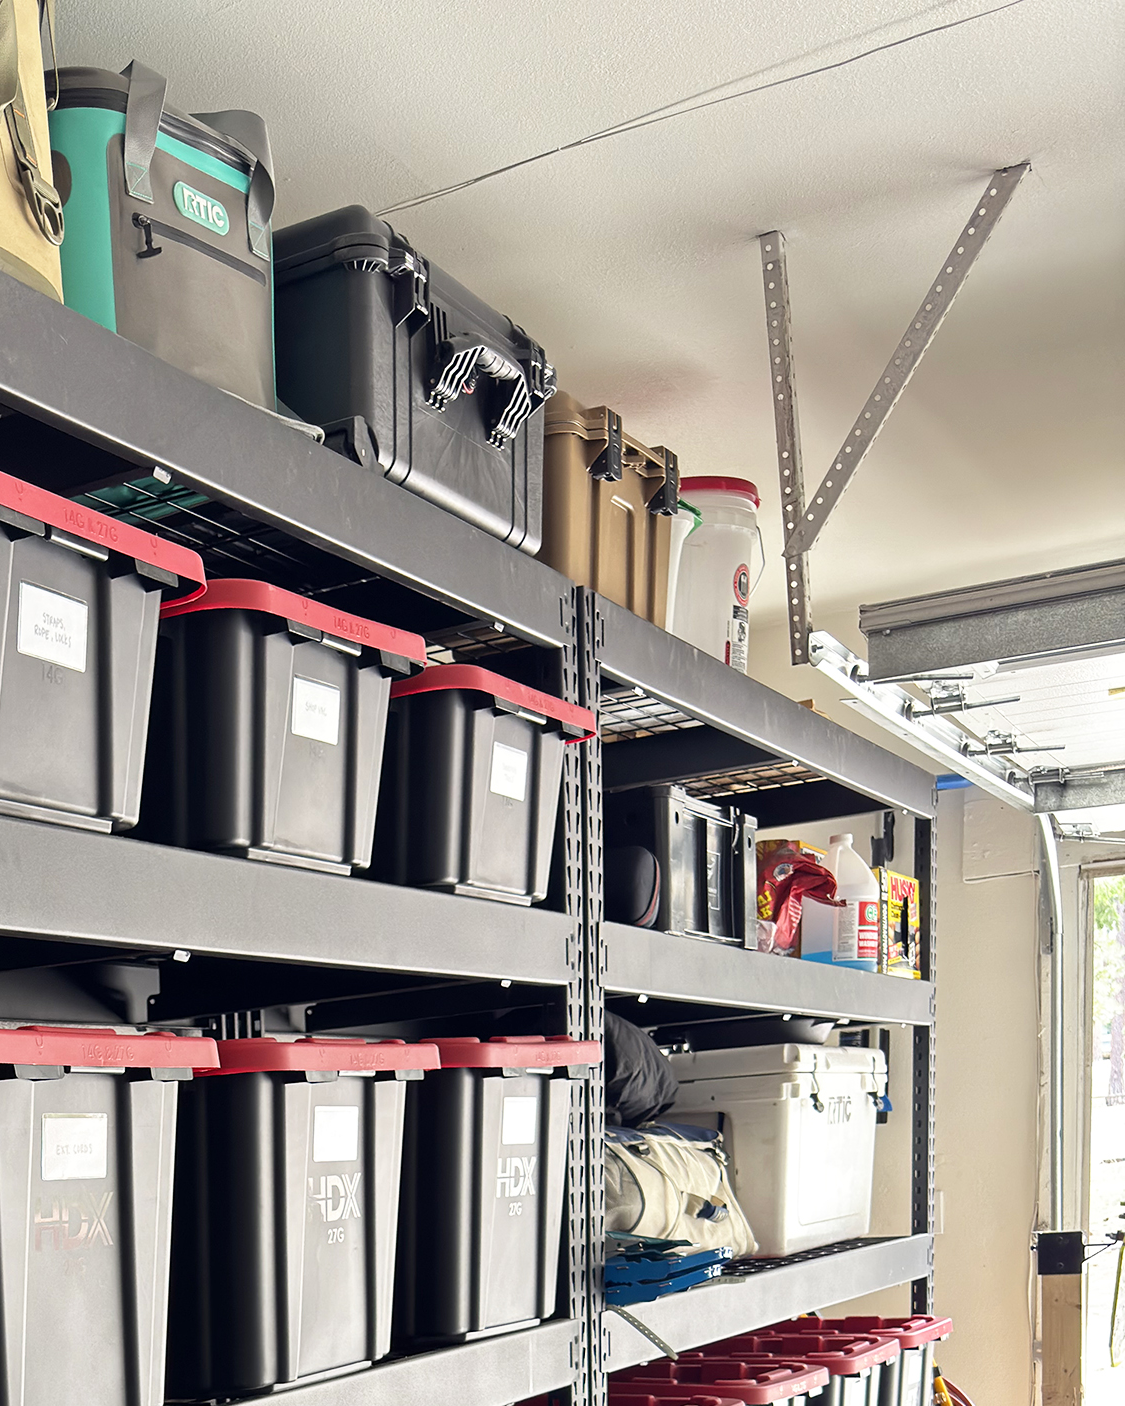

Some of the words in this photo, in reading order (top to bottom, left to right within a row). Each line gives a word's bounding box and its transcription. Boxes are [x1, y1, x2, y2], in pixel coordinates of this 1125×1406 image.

[182, 187, 225, 228] RTIC
[63, 508, 85, 530] 14G
[97, 521, 119, 542] 27G
[40, 662, 64, 685] 14G
[496, 1156, 537, 1198] HDX
[307, 1172, 362, 1222] HDX
[508, 1202, 523, 1216] 27G
[34, 1191, 114, 1252] HDX
[327, 1227, 345, 1244] 27G
